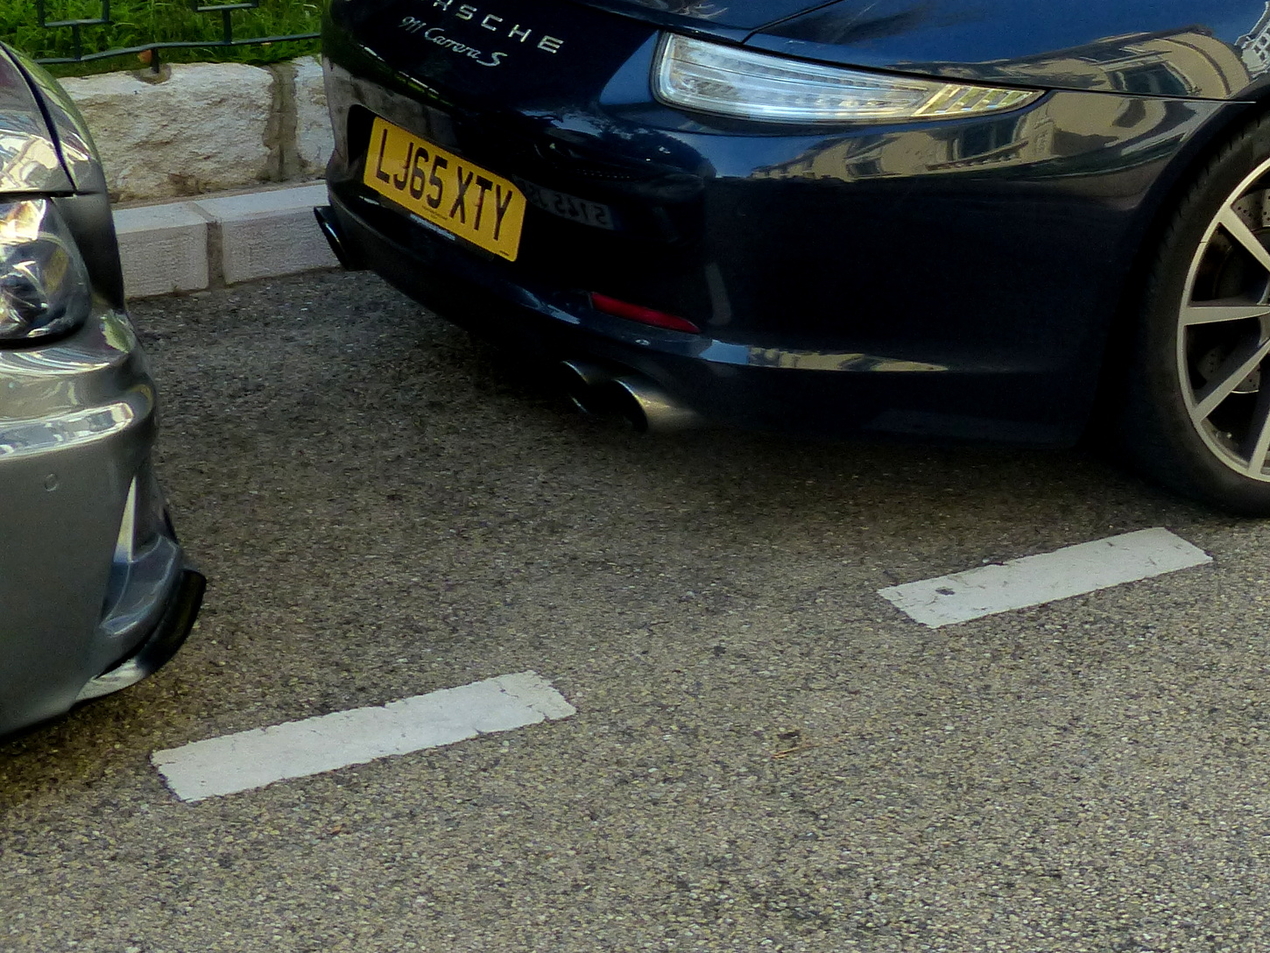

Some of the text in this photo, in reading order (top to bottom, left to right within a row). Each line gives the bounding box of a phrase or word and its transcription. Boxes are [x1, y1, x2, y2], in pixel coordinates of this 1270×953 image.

[399, 16, 508, 66] 911 Carrera S
[375, 128, 513, 240] LJ65 XTY
